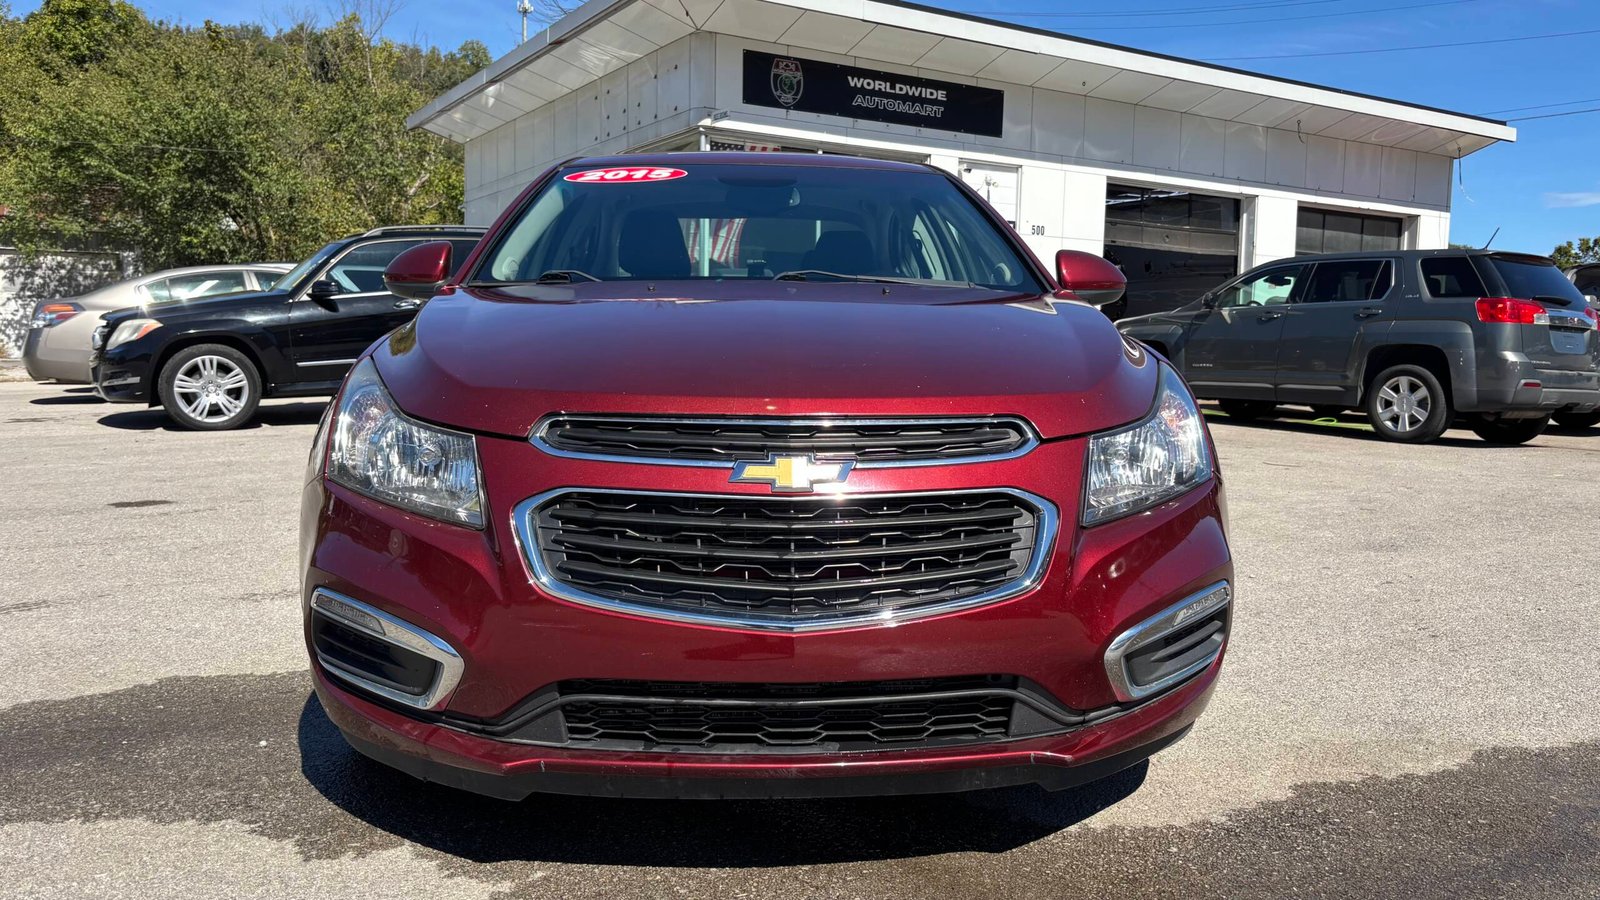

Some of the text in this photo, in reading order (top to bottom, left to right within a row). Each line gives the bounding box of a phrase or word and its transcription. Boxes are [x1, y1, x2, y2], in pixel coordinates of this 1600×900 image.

[847, 75, 948, 101] WORLDWIDE
[852, 94, 945, 118] AUTOMART
[576, 168, 674, 182] 2015
[1031, 224, 1046, 236] 500
